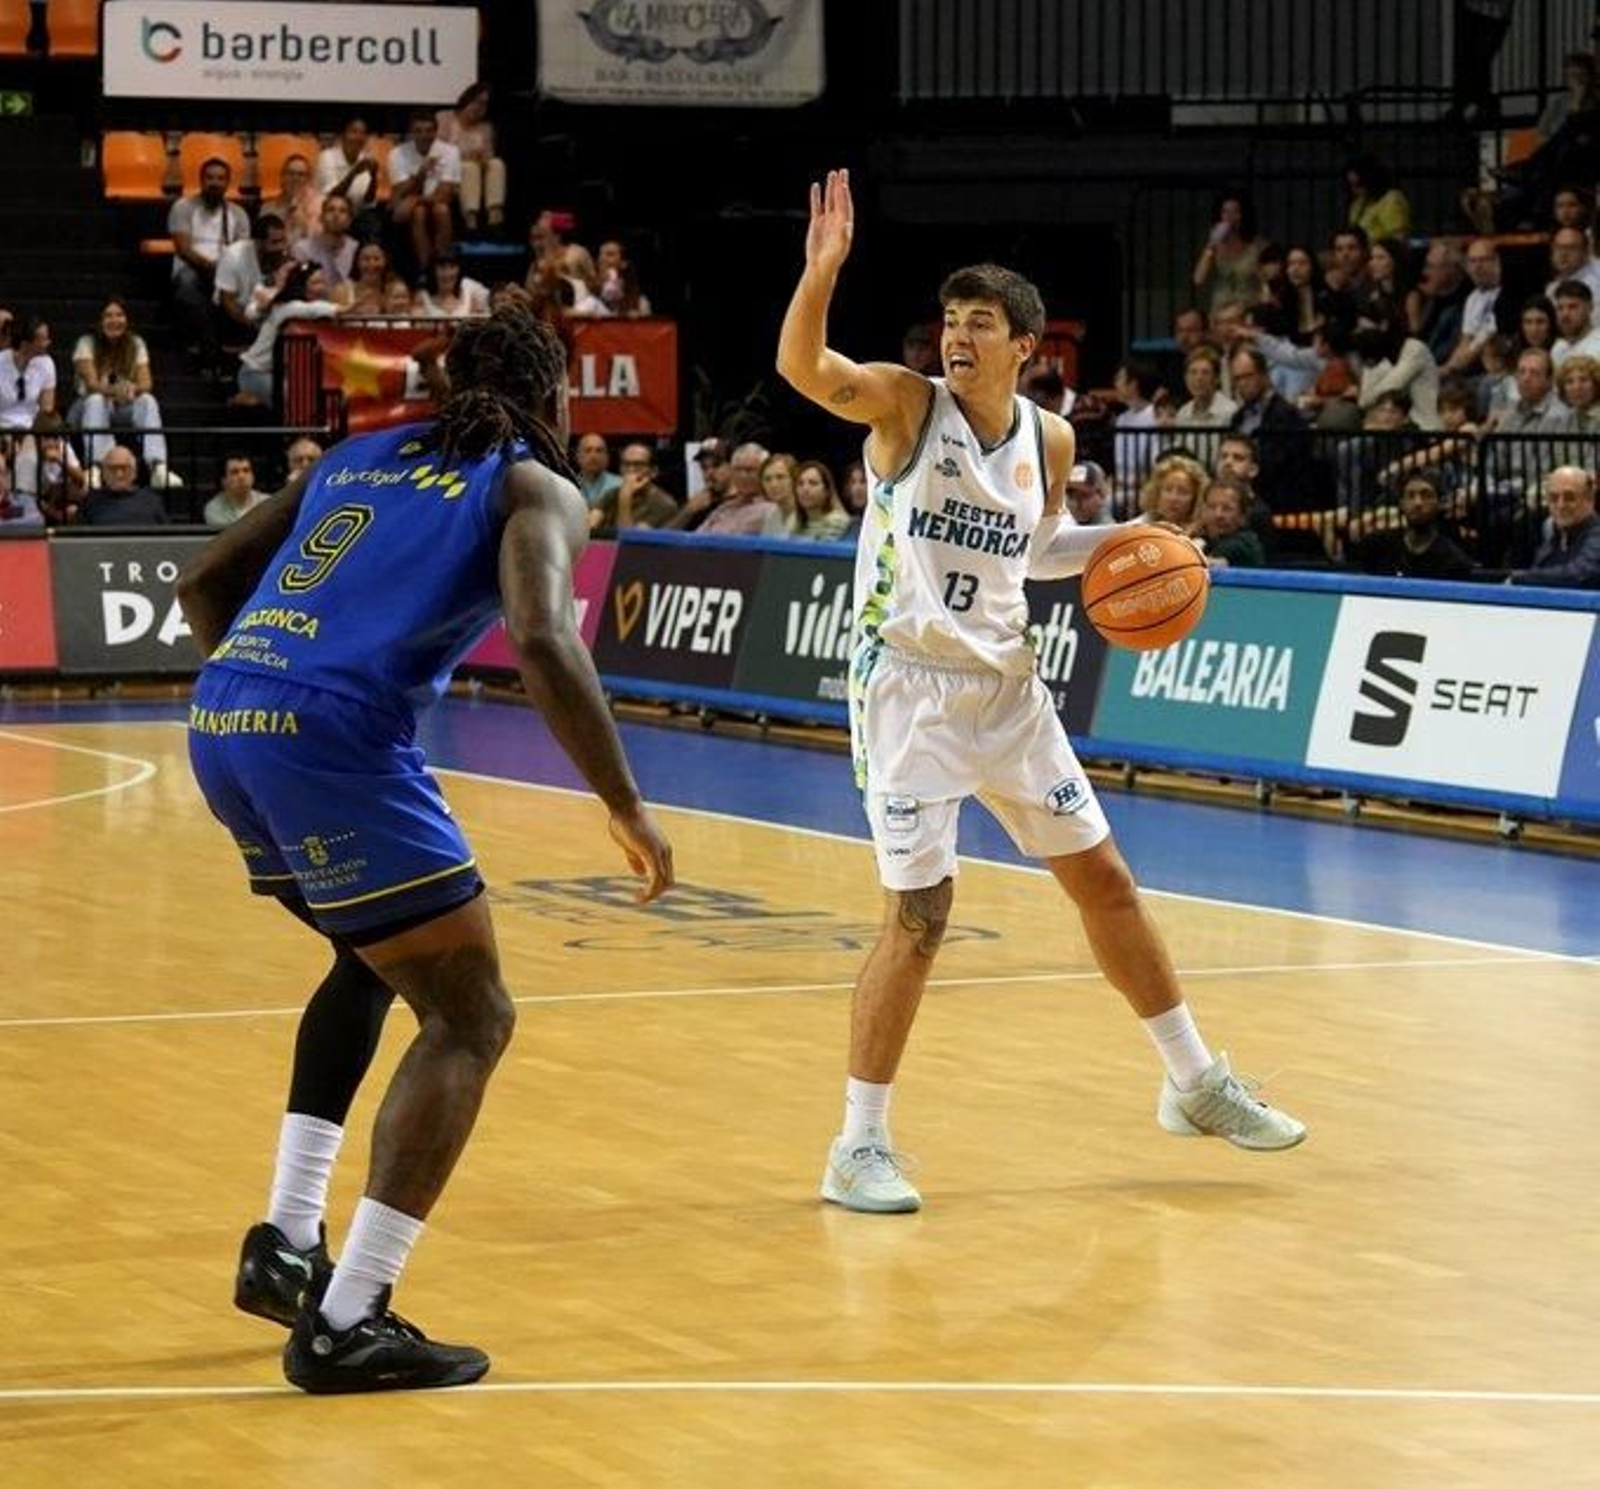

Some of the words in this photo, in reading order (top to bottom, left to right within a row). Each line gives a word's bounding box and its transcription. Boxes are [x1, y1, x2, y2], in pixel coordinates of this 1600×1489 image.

[202, 22, 441, 65] barbercoll
[907, 507, 1030, 559] MENORCA
[942, 498, 1016, 530] HESTIA
[278, 502, 375, 594] 9
[100, 561, 178, 583] TRO
[944, 571, 980, 612] 13
[102, 590, 193, 646] DA
[644, 583, 743, 655] VIPER
[1431, 679, 1538, 719] SEAT
